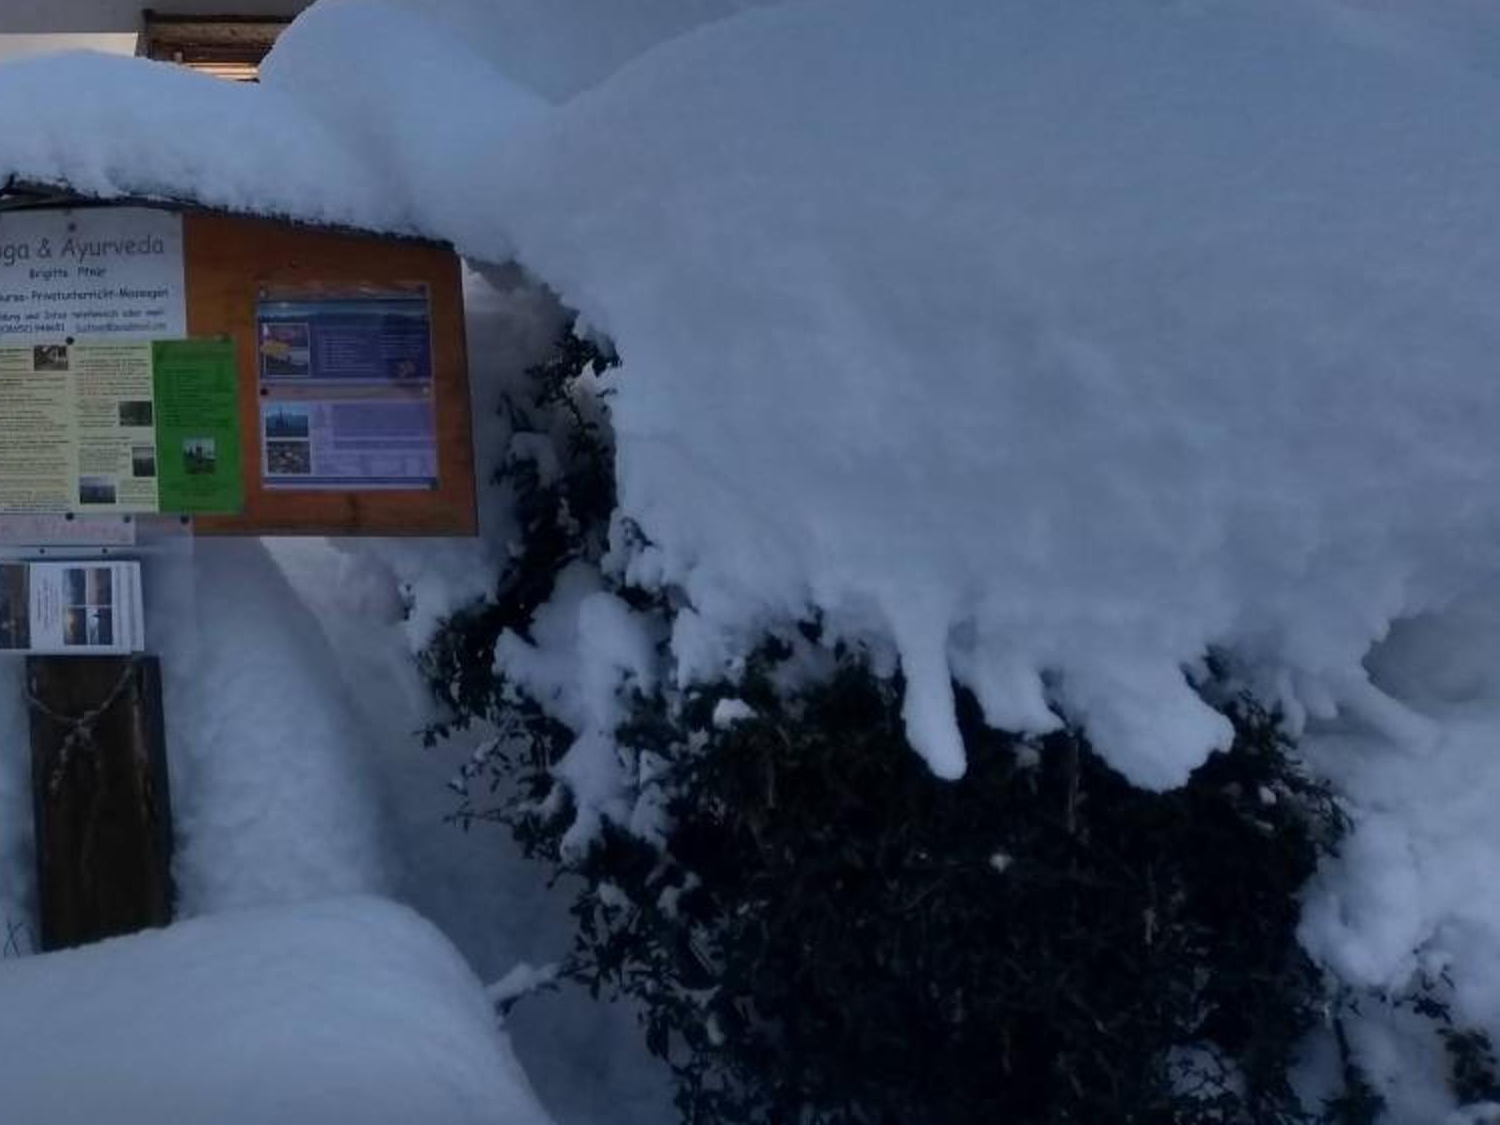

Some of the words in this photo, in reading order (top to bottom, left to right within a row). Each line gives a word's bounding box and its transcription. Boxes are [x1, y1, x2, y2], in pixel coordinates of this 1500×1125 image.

[36, 238, 53, 259] &
[61, 234, 165, 265] Ayurveda
[29, 267, 69, 281] Brigitte
